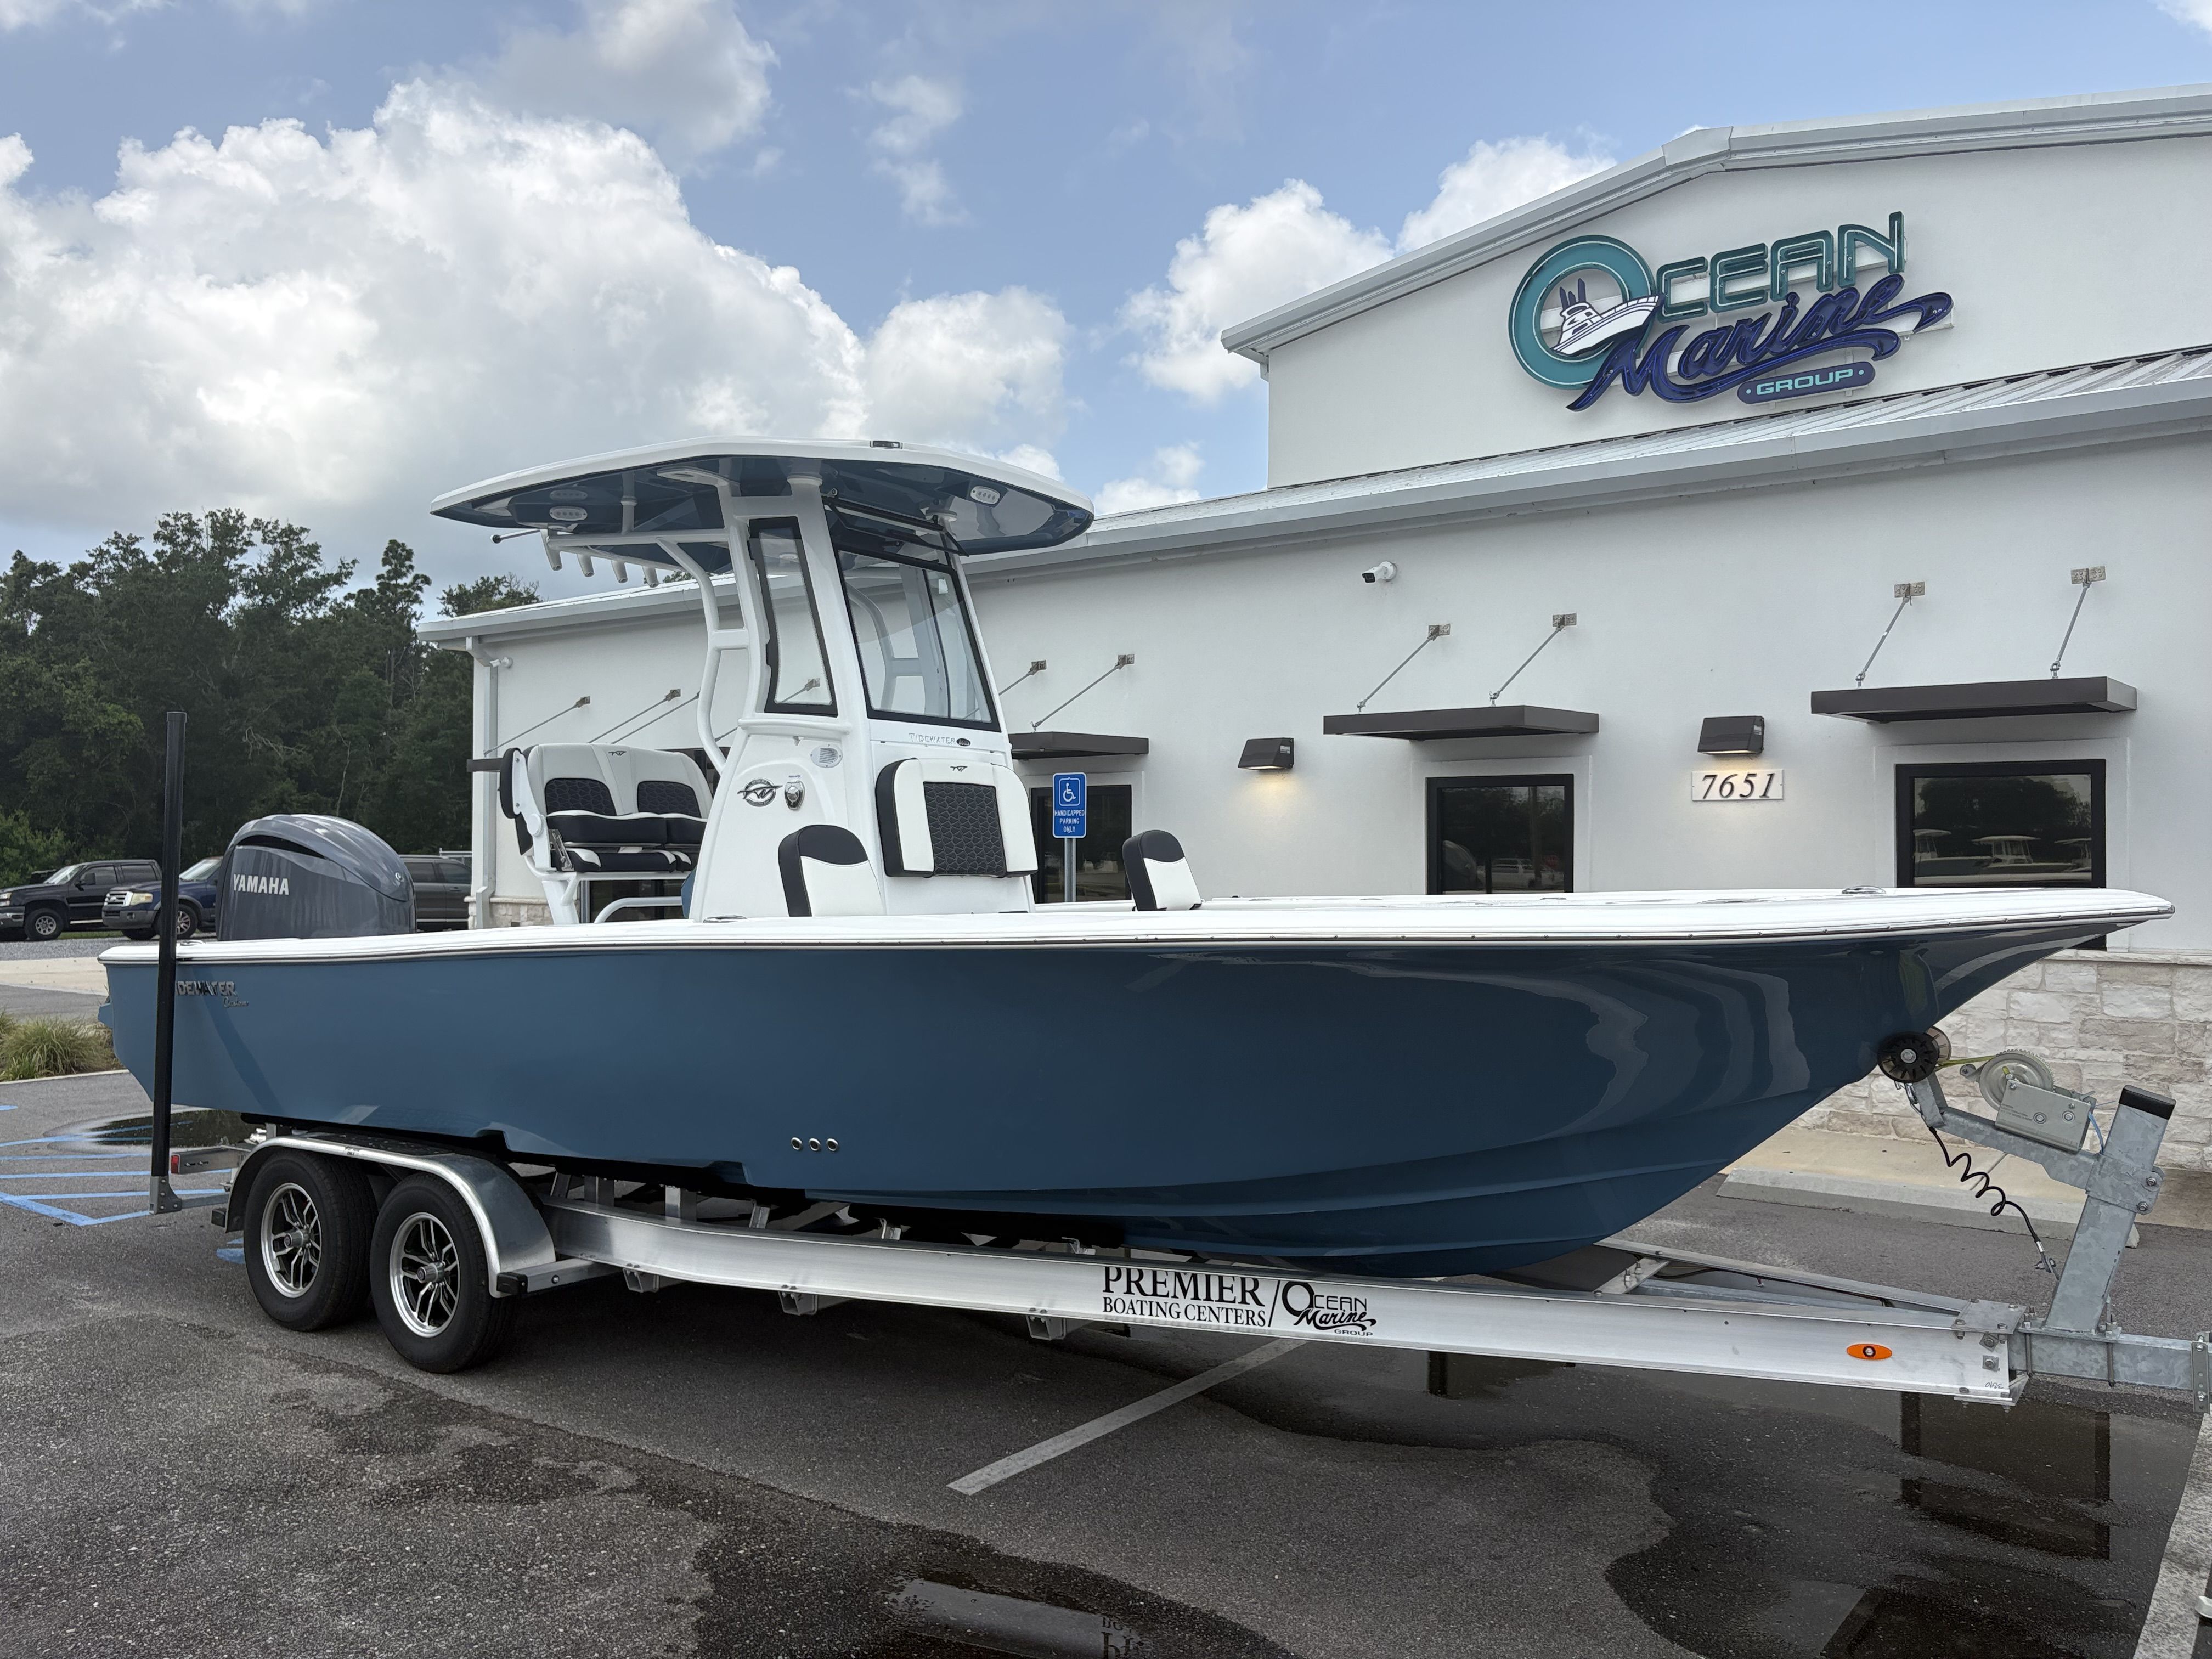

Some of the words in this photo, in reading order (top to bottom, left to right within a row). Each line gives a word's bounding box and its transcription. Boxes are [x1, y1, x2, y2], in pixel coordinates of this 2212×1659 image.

[1508, 211, 1905, 390] OCEAN
[1565, 273, 1954, 413] Marine
[1756, 368, 1854, 396] GROUP
[908, 732, 956, 744] TIDEWATER
[1702, 772, 1775, 799] 7651
[233, 873, 289, 895] YAMAHA
[175, 980, 238, 996] DEWATER
[1103, 1266, 1265, 1307] PREMIER
[1282, 1280, 1367, 1317] OCEAN
[1103, 1296, 1181, 1319] BOATING
[1184, 1304, 1266, 1327] CENTERS
[1293, 1308, 1377, 1331] Marine
[1334, 1329, 1374, 1337] GROUP
